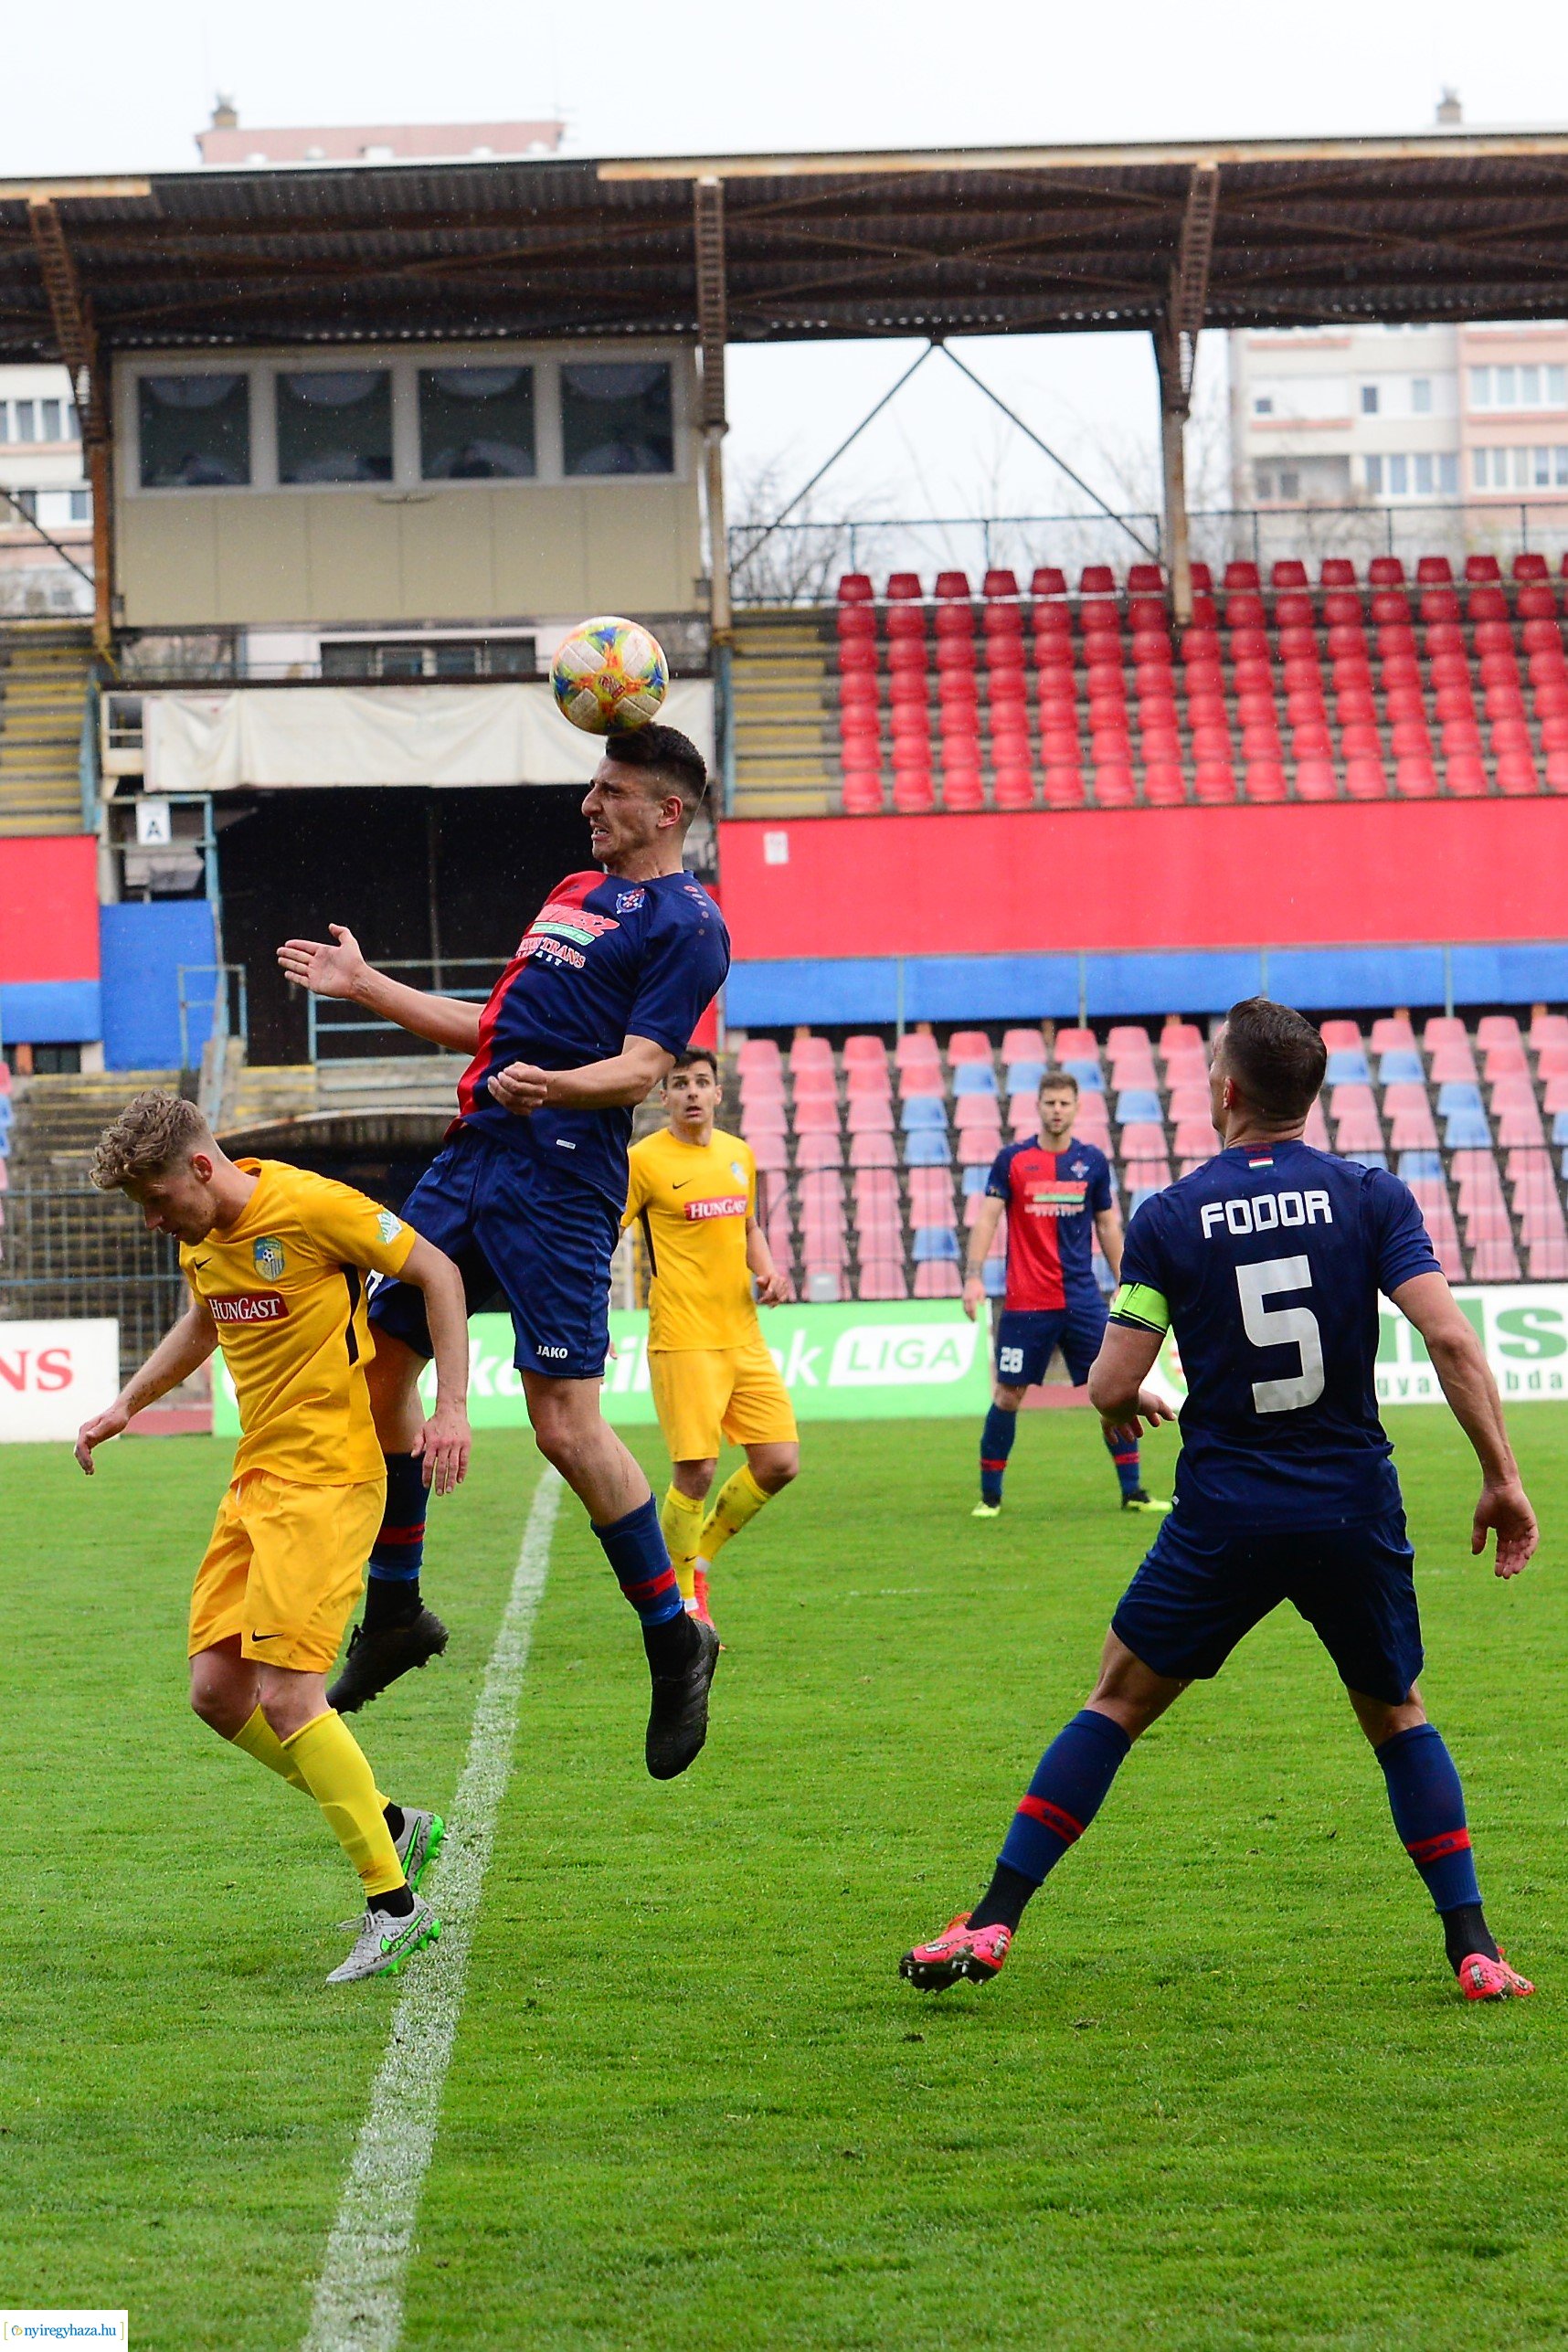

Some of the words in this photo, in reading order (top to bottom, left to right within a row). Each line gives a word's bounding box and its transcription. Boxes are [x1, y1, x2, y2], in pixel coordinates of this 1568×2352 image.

[146, 820, 163, 837] A
[1200, 1190, 1332, 1239] FODOR
[1235, 1255, 1324, 1413] 5
[535, 1345, 567, 1359] JAKO
[848, 1338, 959, 1371] LIGA
[1000, 1347, 1023, 1373] 28
